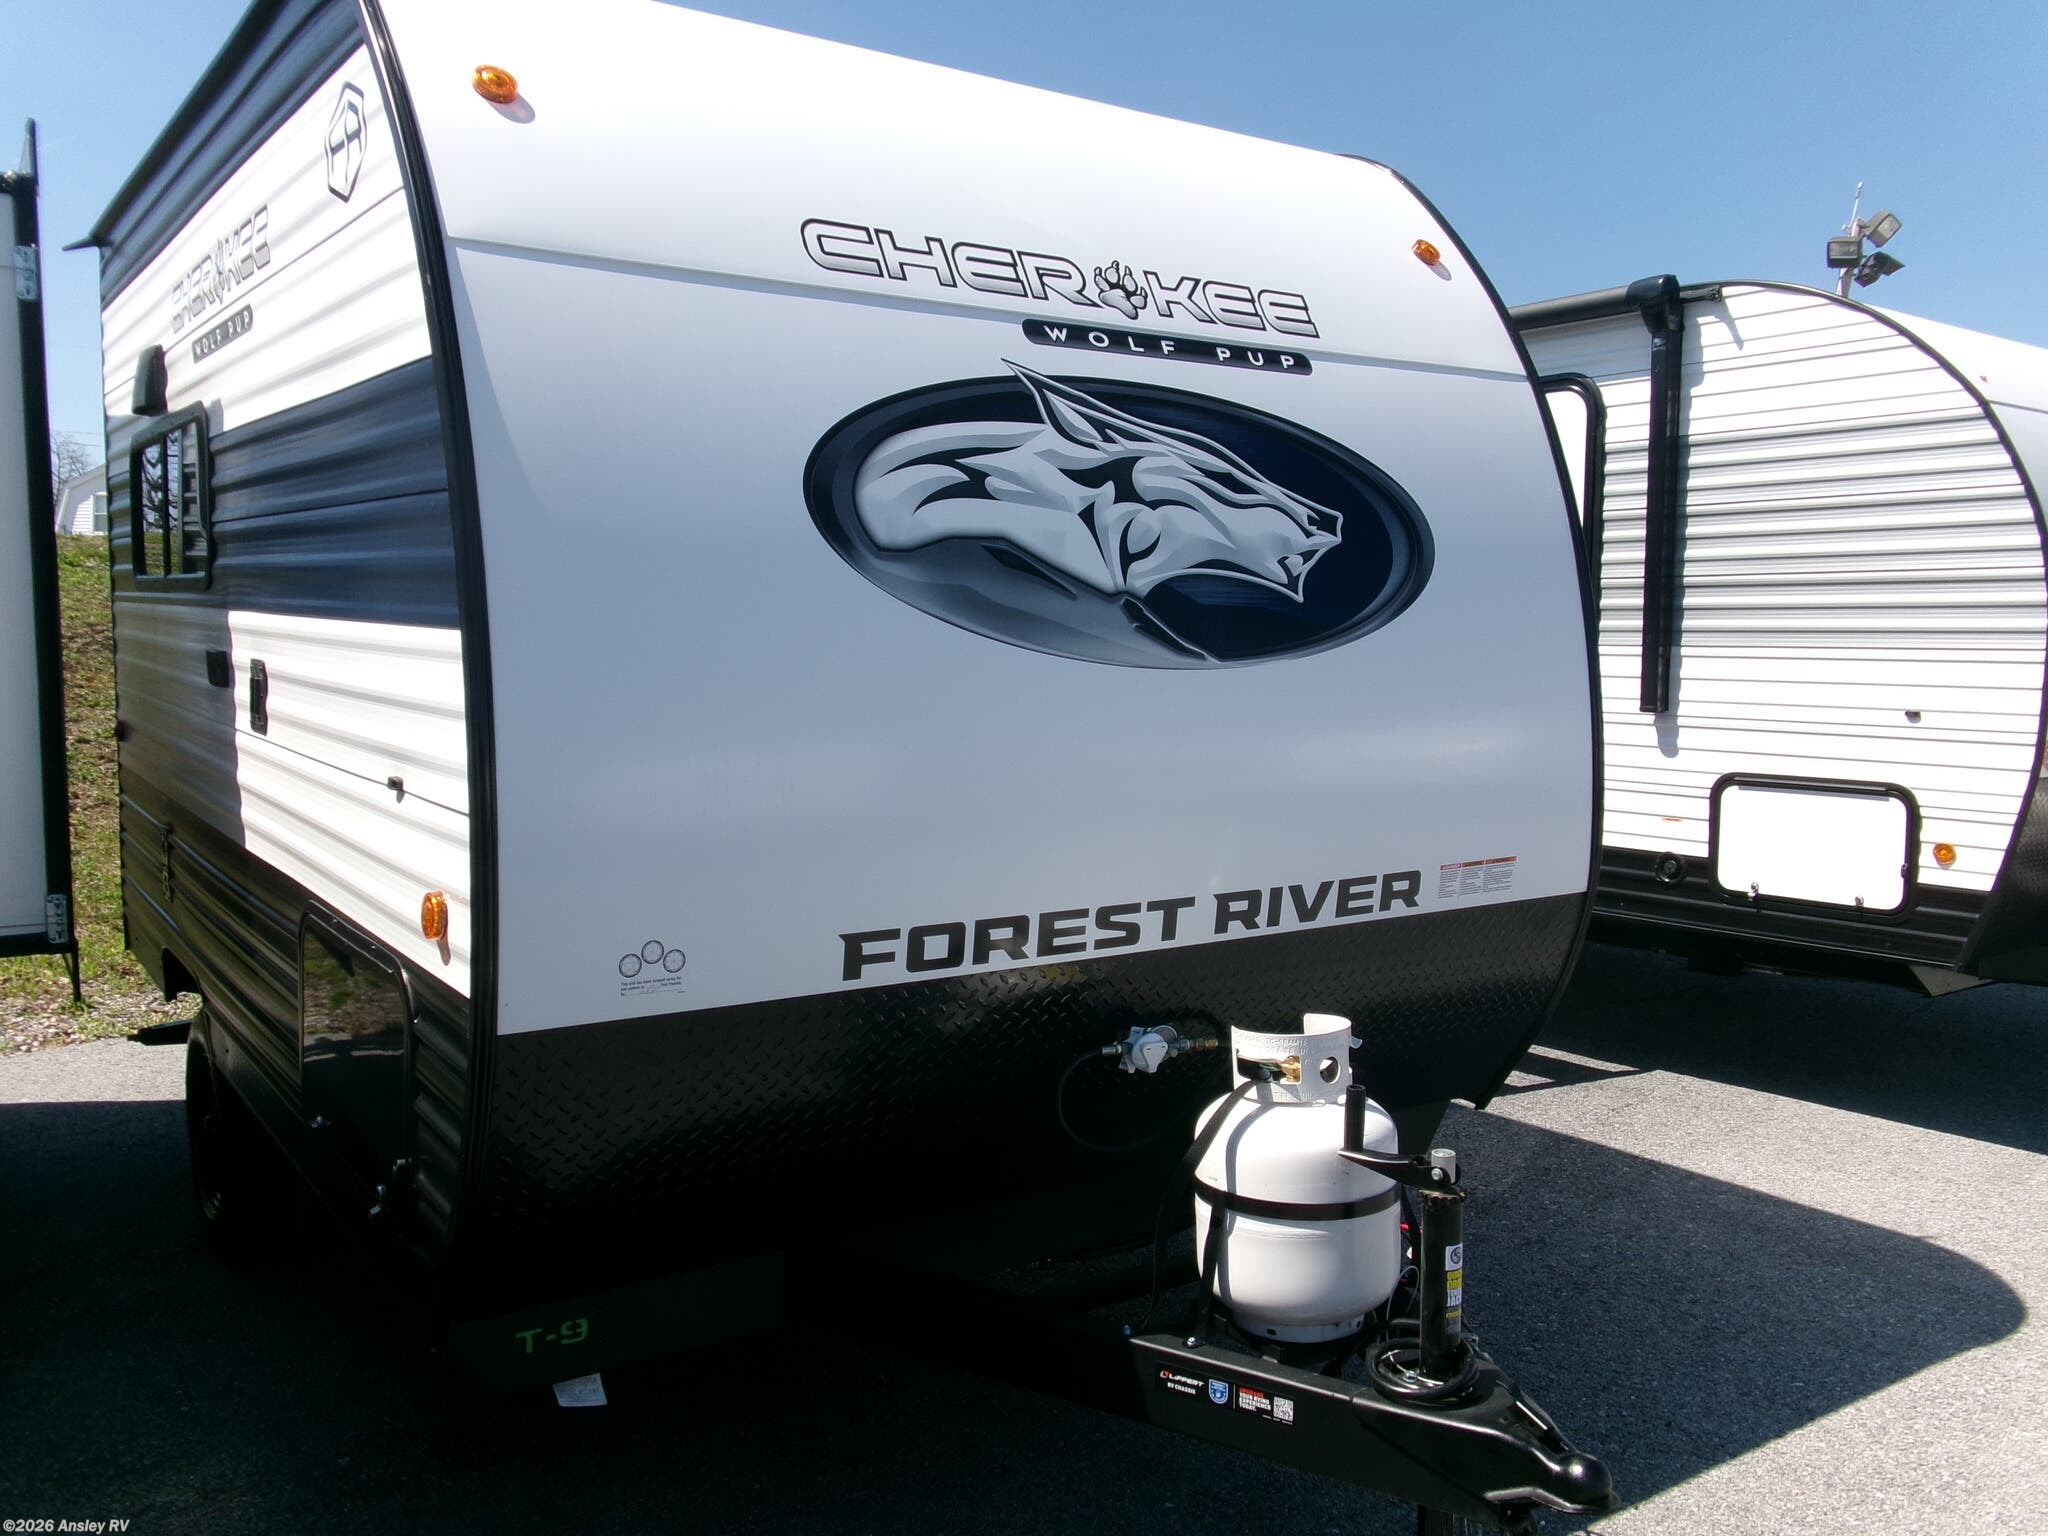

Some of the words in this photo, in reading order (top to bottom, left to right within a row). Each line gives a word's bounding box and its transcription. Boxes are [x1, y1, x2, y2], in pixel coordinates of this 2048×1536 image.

[194, 328, 221, 356] WOLF
[228, 310, 250, 338] PUP
[1043, 325, 1175, 356] WOLF
[1217, 347, 1296, 370] PUP
[837, 896, 1196, 982] FOREST
[1213, 869, 1422, 935] RIVER
[516, 1318, 588, 1353] T-9
